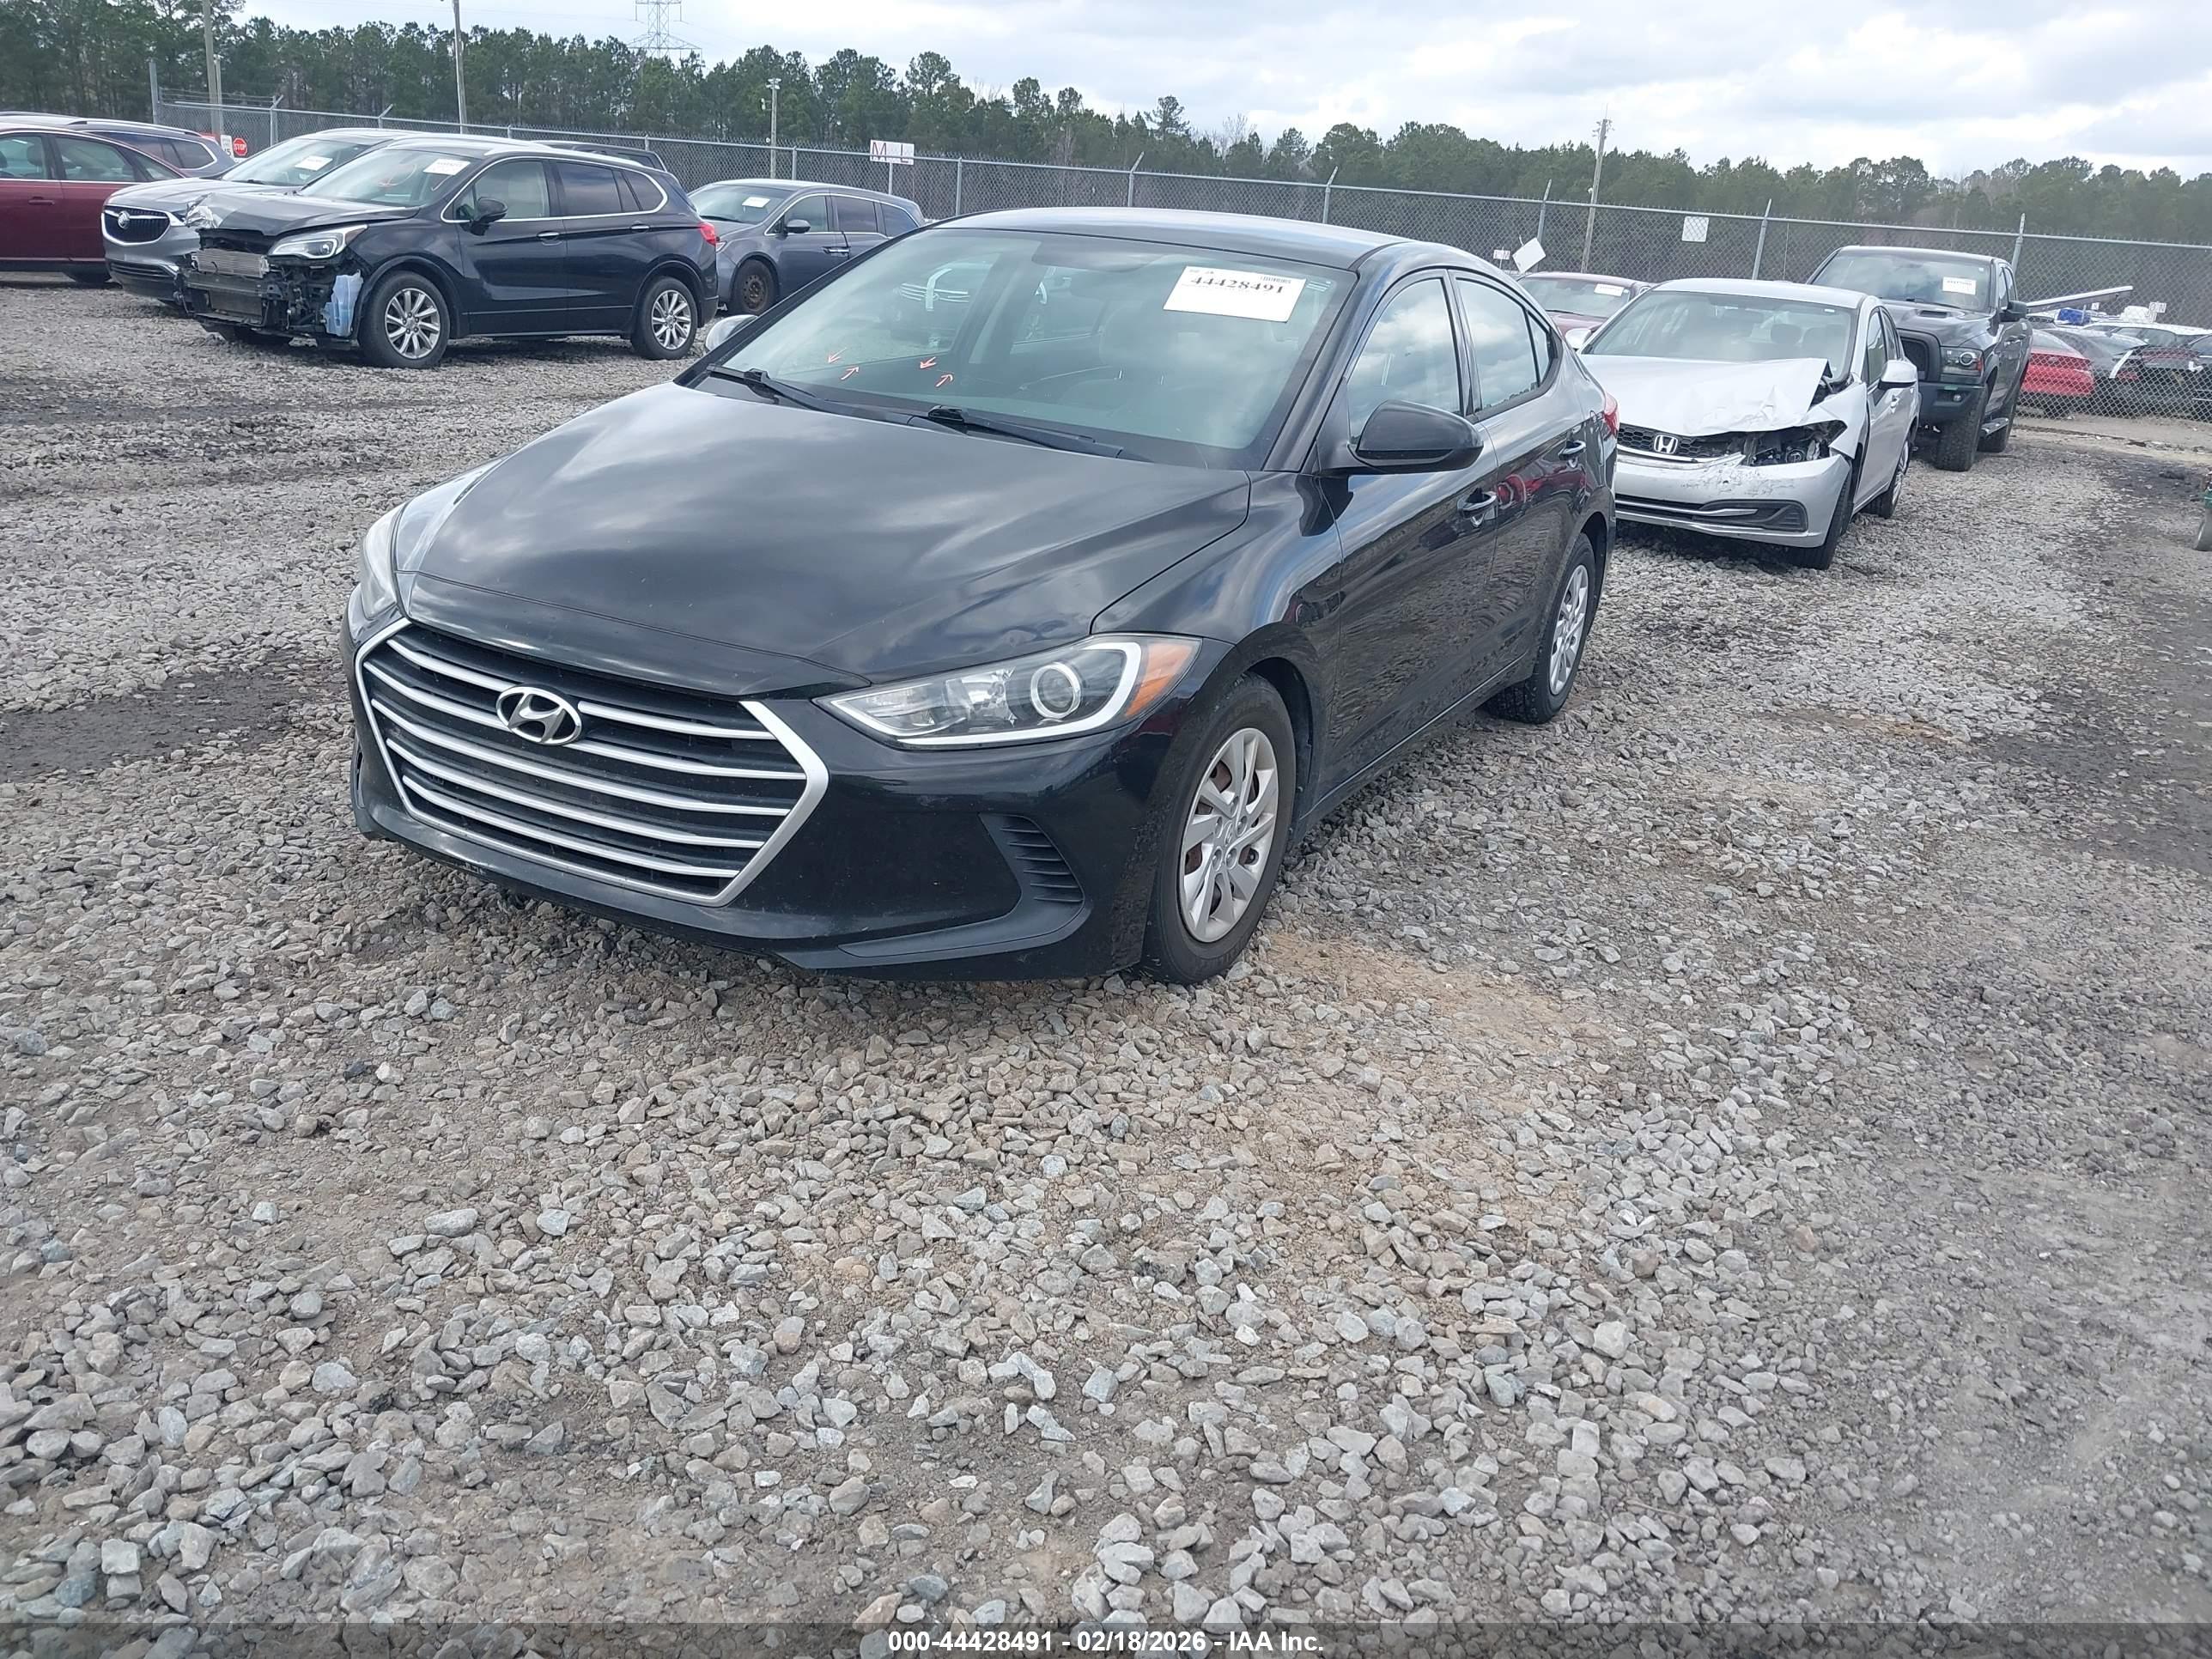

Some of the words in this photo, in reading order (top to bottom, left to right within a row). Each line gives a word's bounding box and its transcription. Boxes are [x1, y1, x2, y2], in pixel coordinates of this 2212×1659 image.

[234, 143, 246, 151] STOP
[872, 142, 887, 162] M
[901, 143, 909, 163] L
[1191, 276, 1285, 294] 44428491
